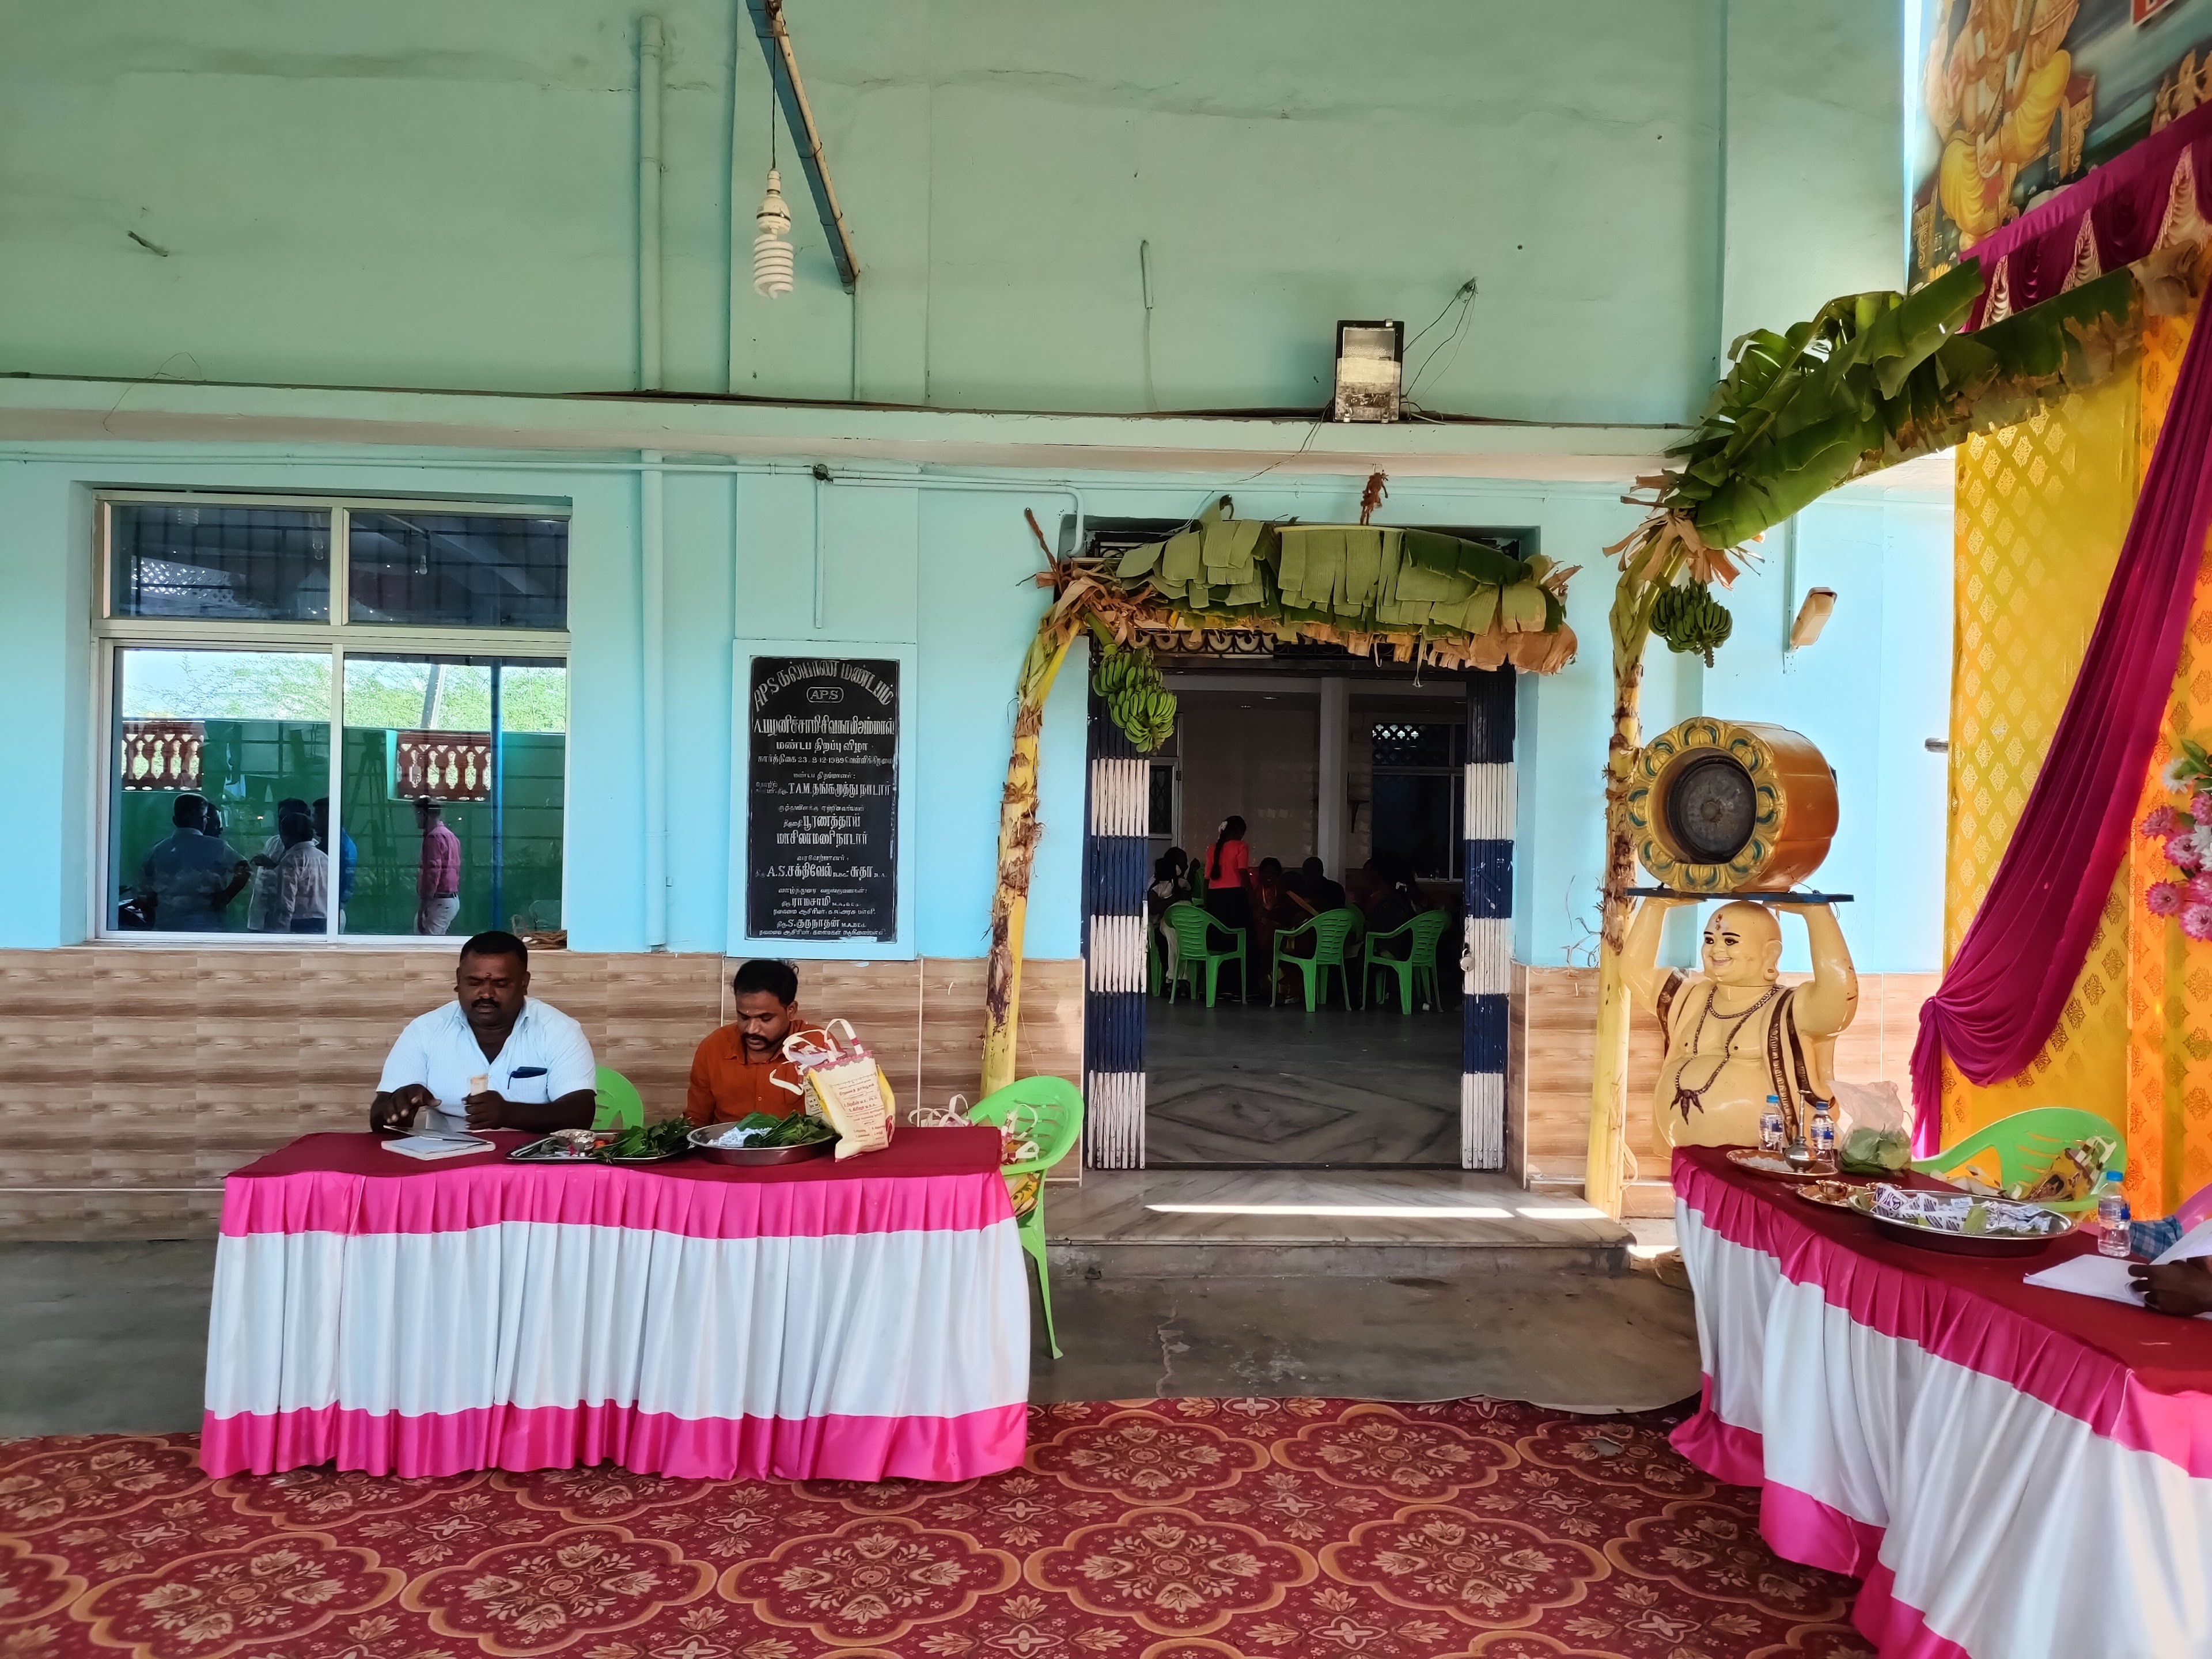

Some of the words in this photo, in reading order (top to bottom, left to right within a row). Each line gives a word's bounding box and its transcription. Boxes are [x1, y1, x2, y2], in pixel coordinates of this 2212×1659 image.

[753, 677, 779, 712] APS
[810, 690, 839, 700] APS
[776, 739, 812, 750] மண்டப
[814, 737, 842, 753] திறப்பு
[843, 739, 869, 753] விழா
